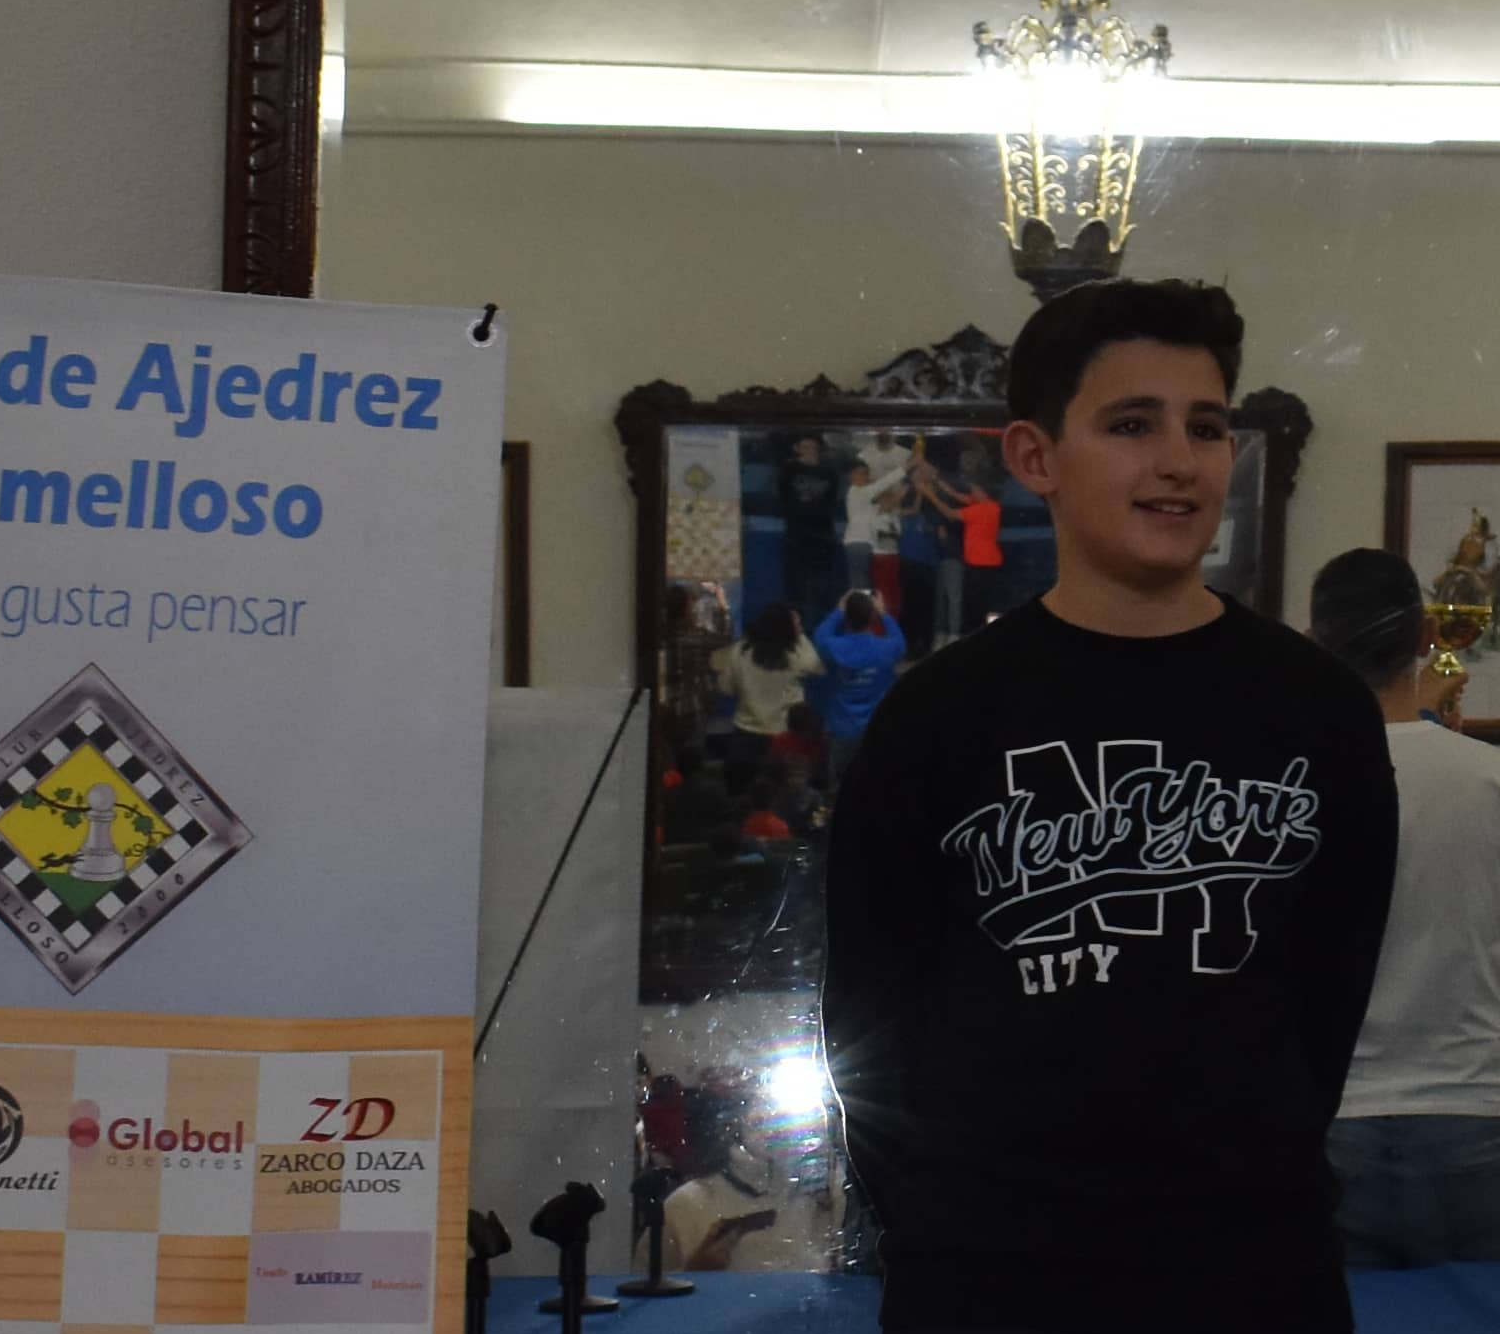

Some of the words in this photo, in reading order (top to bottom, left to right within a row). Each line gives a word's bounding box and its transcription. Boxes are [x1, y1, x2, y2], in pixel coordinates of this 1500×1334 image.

[115, 342, 443, 438] Ajedrez
[0, 581, 132, 637] gusta
[148, 588, 306, 643] pensar
[940, 791, 1131, 896] New
[1110, 756, 1320, 867] York
[1018, 943, 1120, 995] CITY
[108, 1118, 244, 1153] Global
[300, 1097, 395, 1142] ZD
[261, 1152, 345, 1173] ZARCO
[355, 1151, 424, 1171] DAZA
[286, 1178, 400, 1195] ABOGADOS
